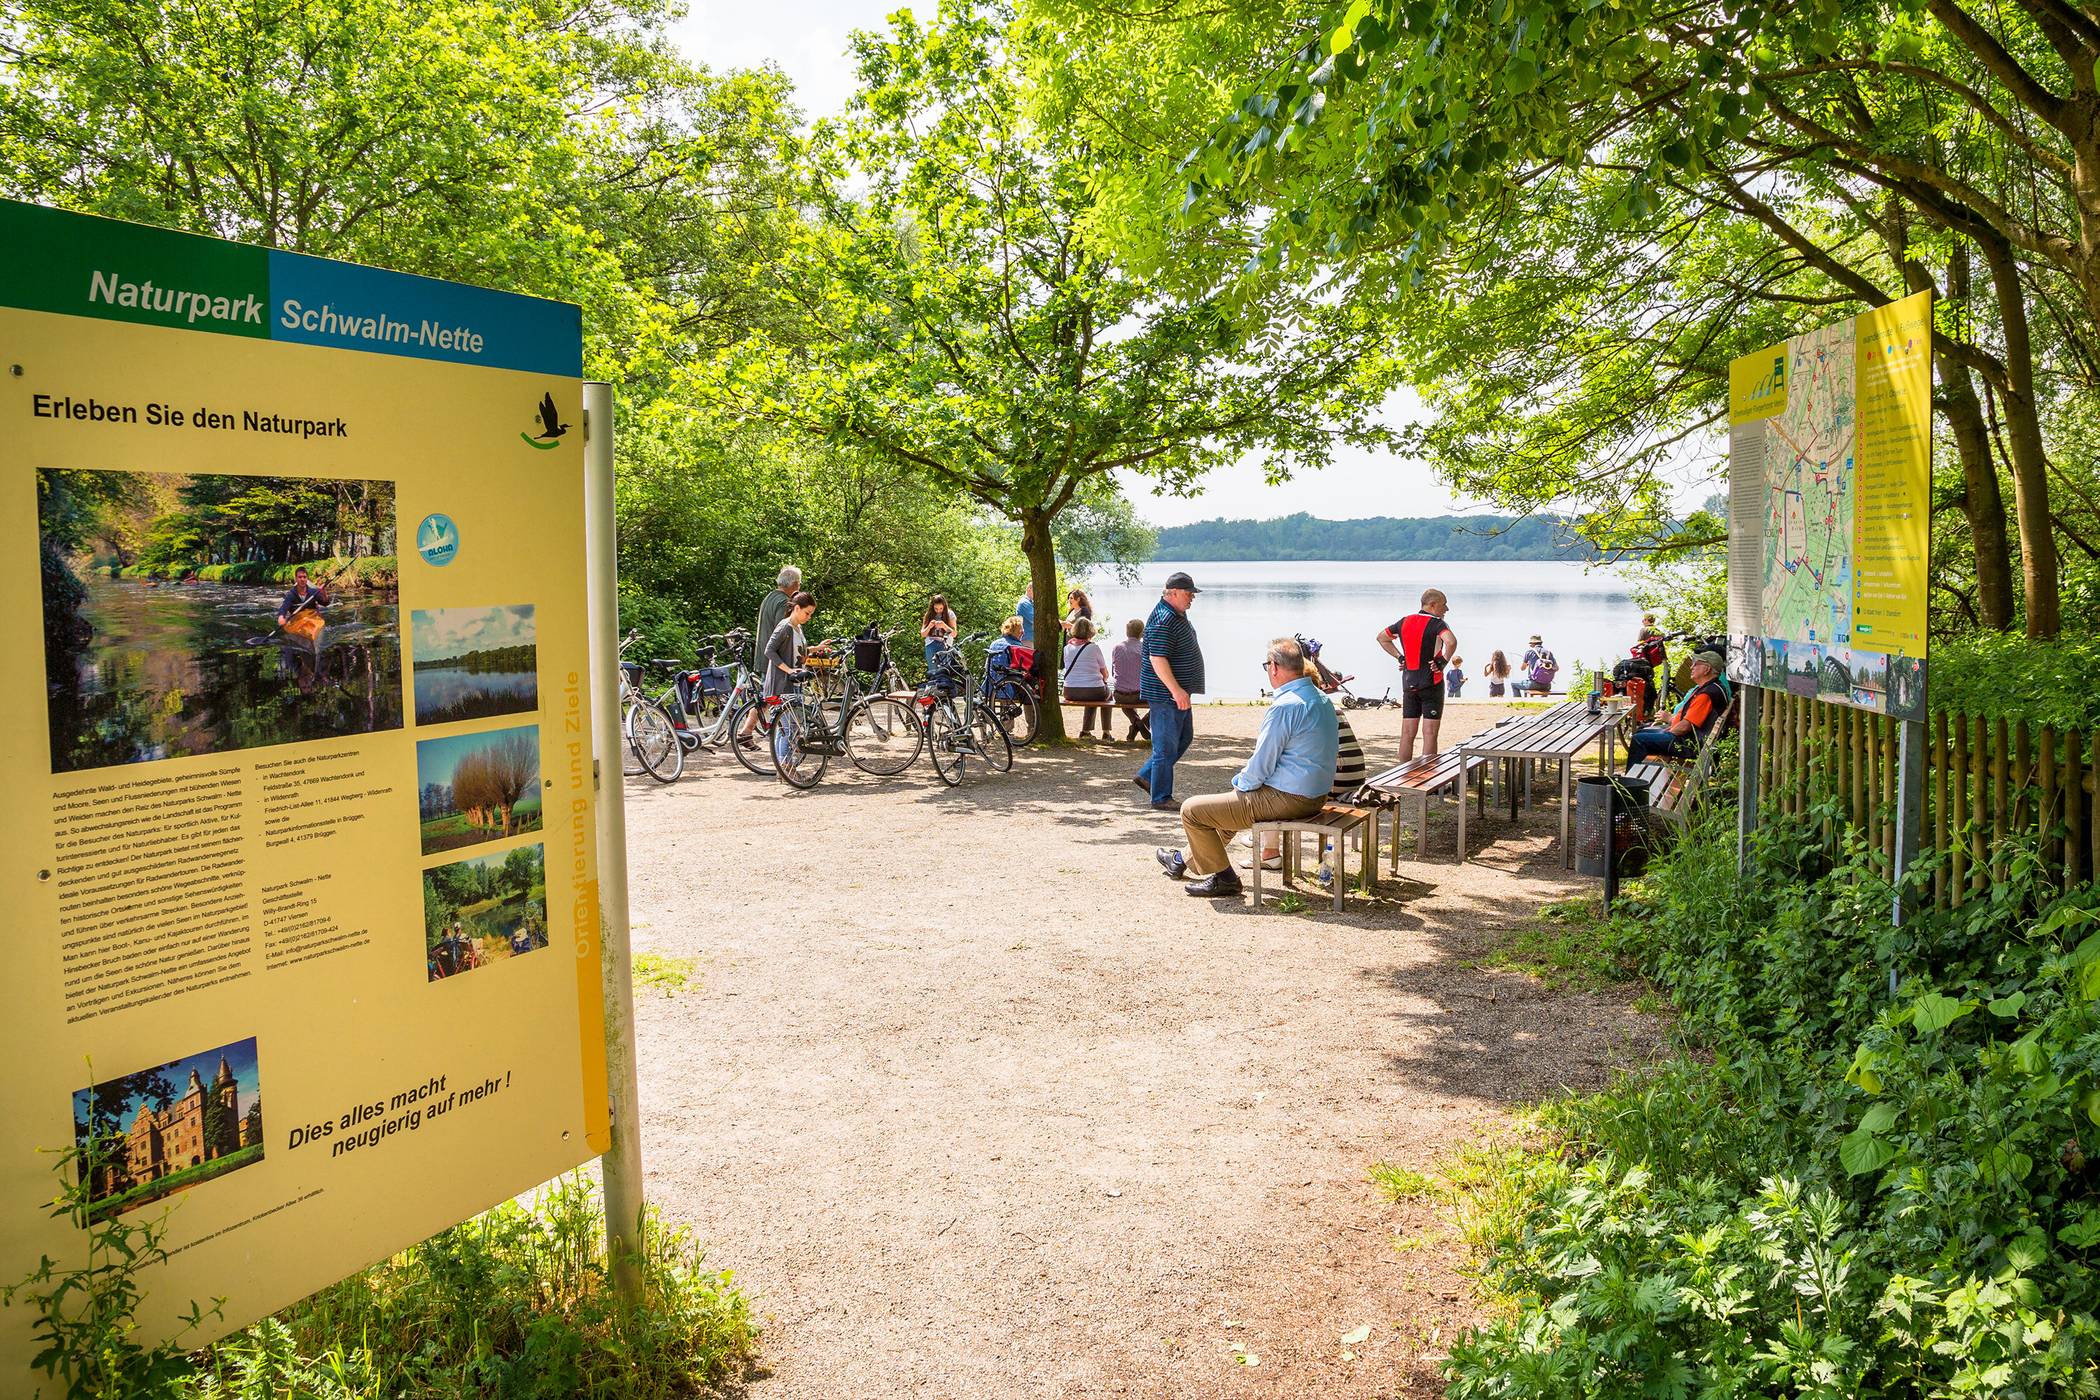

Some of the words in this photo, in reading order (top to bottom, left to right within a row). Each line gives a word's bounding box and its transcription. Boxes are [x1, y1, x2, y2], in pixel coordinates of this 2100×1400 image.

[89, 270, 264, 324] Naturpark
[281, 299, 484, 354] Schwalm-Nette
[33, 395, 136, 423] Erleben
[147, 404, 184, 426] Sie
[193, 408, 234, 429] den
[244, 411, 347, 439] Naturpark
[563, 670, 581, 733] Ziele
[570, 740, 583, 792] und
[571, 798, 590, 959] Orientierung
[289, 1122, 333, 1149] Dies
[340, 1101, 386, 1129] alles
[390, 1075, 448, 1110] macht
[332, 1110, 421, 1158] neugierig
[426, 1094, 456, 1118] auf
[459, 1079, 502, 1107] mehr
[505, 1070, 513, 1088] !
